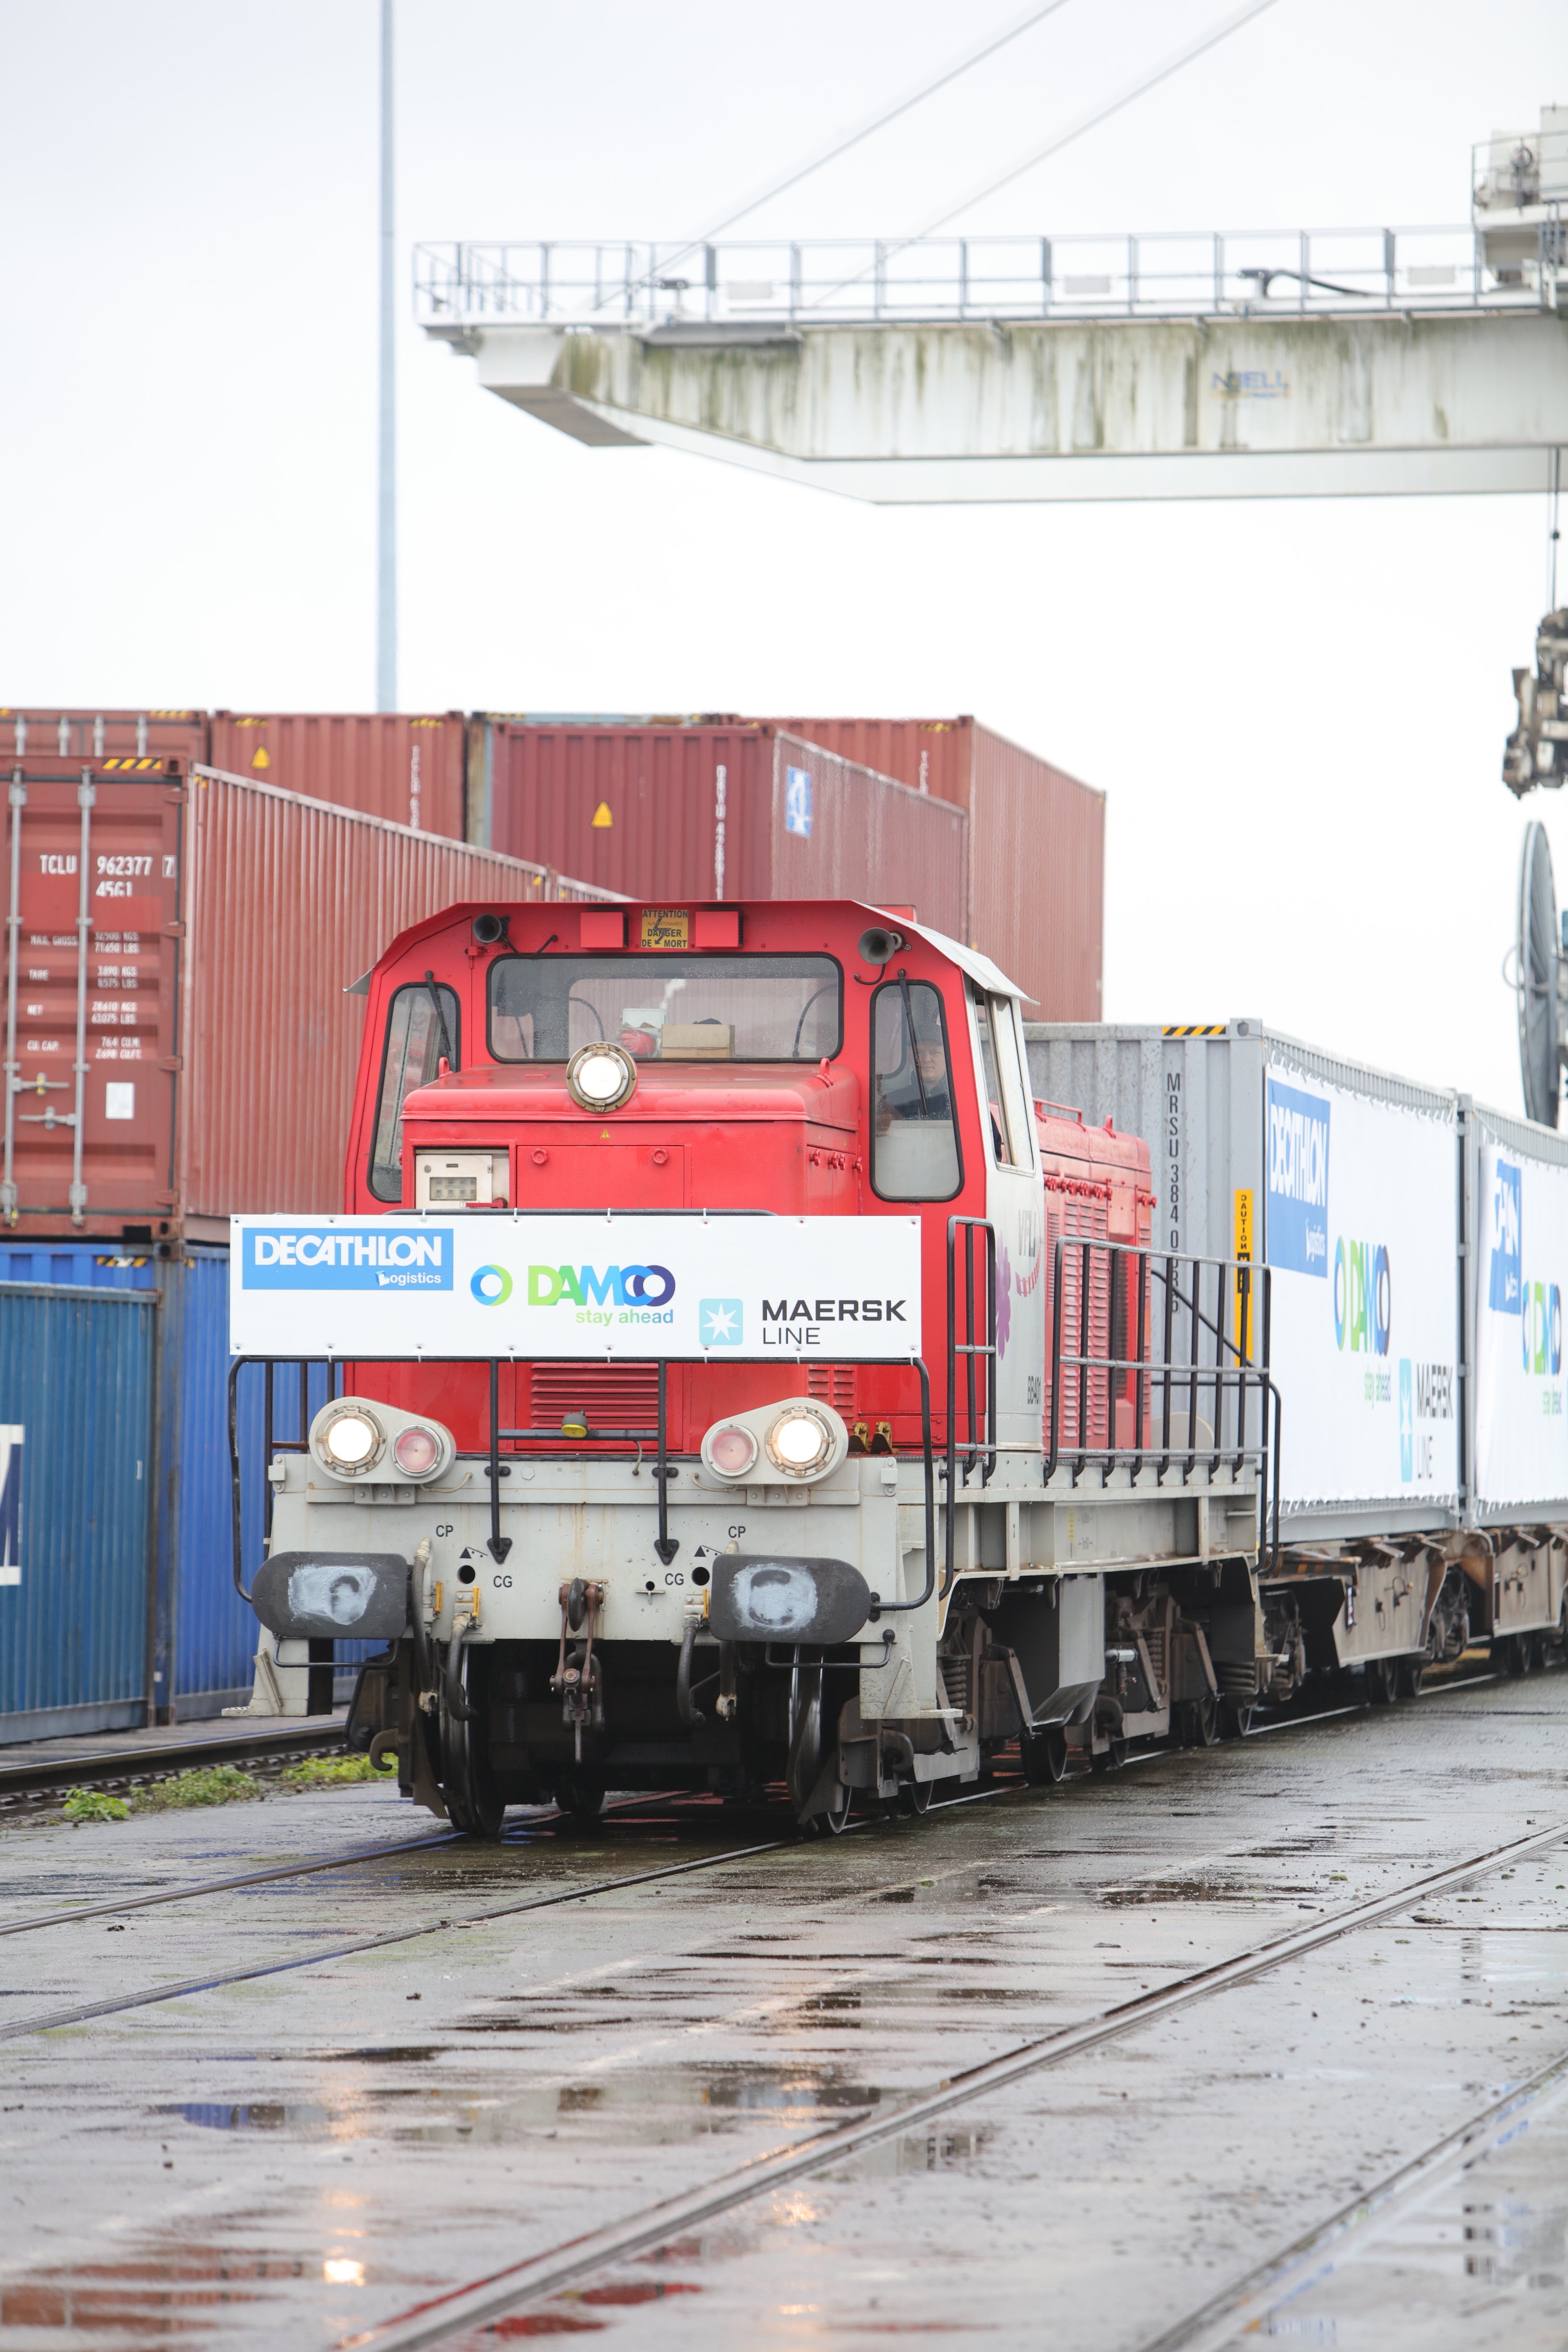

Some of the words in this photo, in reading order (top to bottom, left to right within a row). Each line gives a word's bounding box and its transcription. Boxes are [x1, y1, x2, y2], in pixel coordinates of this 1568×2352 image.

[40, 855, 77, 875] TCLU
[97, 855, 153, 877] 962377
[164, 856, 175, 877] 7
[96, 880, 133, 897] 45G1
[642, 910, 688, 918] ATTENTION
[647, 929, 682, 937] DANGER
[1167, 1073, 1180, 1157] MRSU
[1270, 1102, 1328, 1208] DECATHLON
[1170, 1165, 1179, 1223] 384
[255, 1235, 442, 1266] DECATHLON
[375, 1270, 442, 1286] Logistics
[527, 1264, 676, 1307] DAMCO
[1350, 1239, 1391, 1357] DAMCO
[575, 1309, 614, 1327] stay
[618, 1308, 674, 1324] ahead
[762, 1299, 908, 1321] MAERSK
[763, 1328, 821, 1345] LINE
[1417, 1362, 1454, 1420] MAERSK
[436, 1525, 454, 1537] CP
[728, 1526, 746, 1538] CP
[493, 1575, 513, 1588] CG
[664, 1573, 684, 1586] CG
